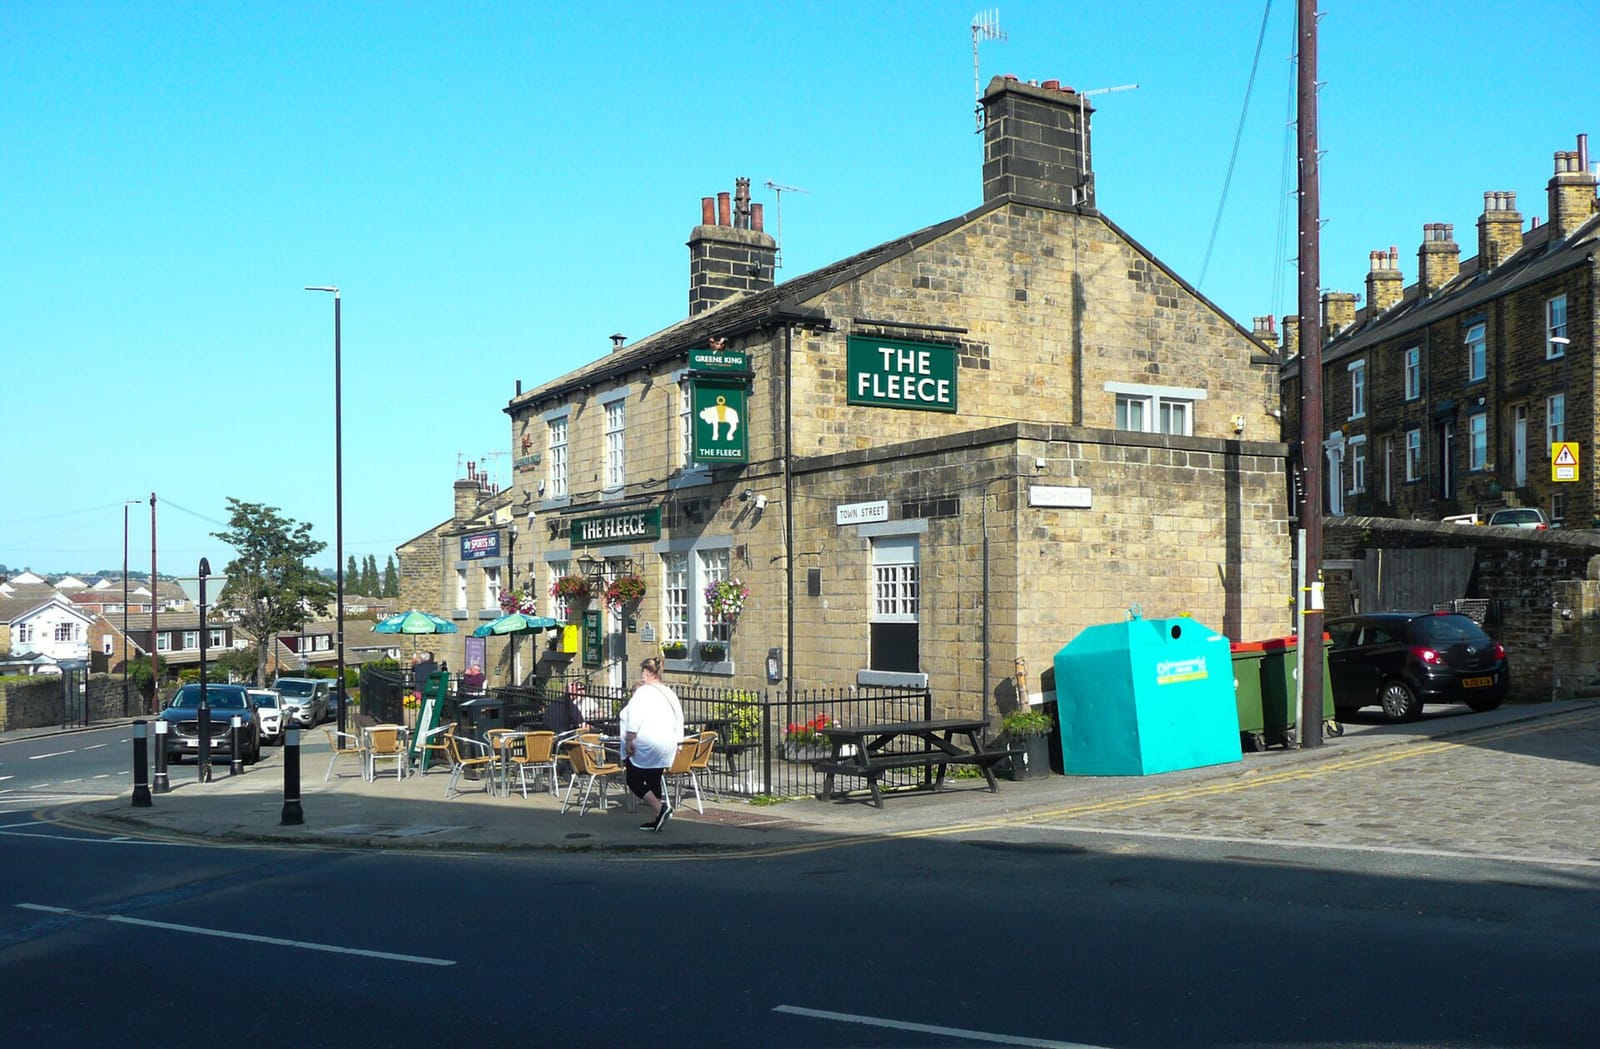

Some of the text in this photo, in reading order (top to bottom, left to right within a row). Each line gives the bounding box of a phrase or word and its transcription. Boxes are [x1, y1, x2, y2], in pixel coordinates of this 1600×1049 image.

[695, 355, 743, 364] GREENE KING
[877, 347, 930, 375] THE
[858, 373, 950, 403] FLEECE
[699, 447, 742, 458] THE FLEECE
[840, 506, 885, 520] TOWN STREET
[581, 514, 645, 541] THE FLEECE
[471, 537, 488, 549] SPORTS
[488, 536, 496, 547] HD
